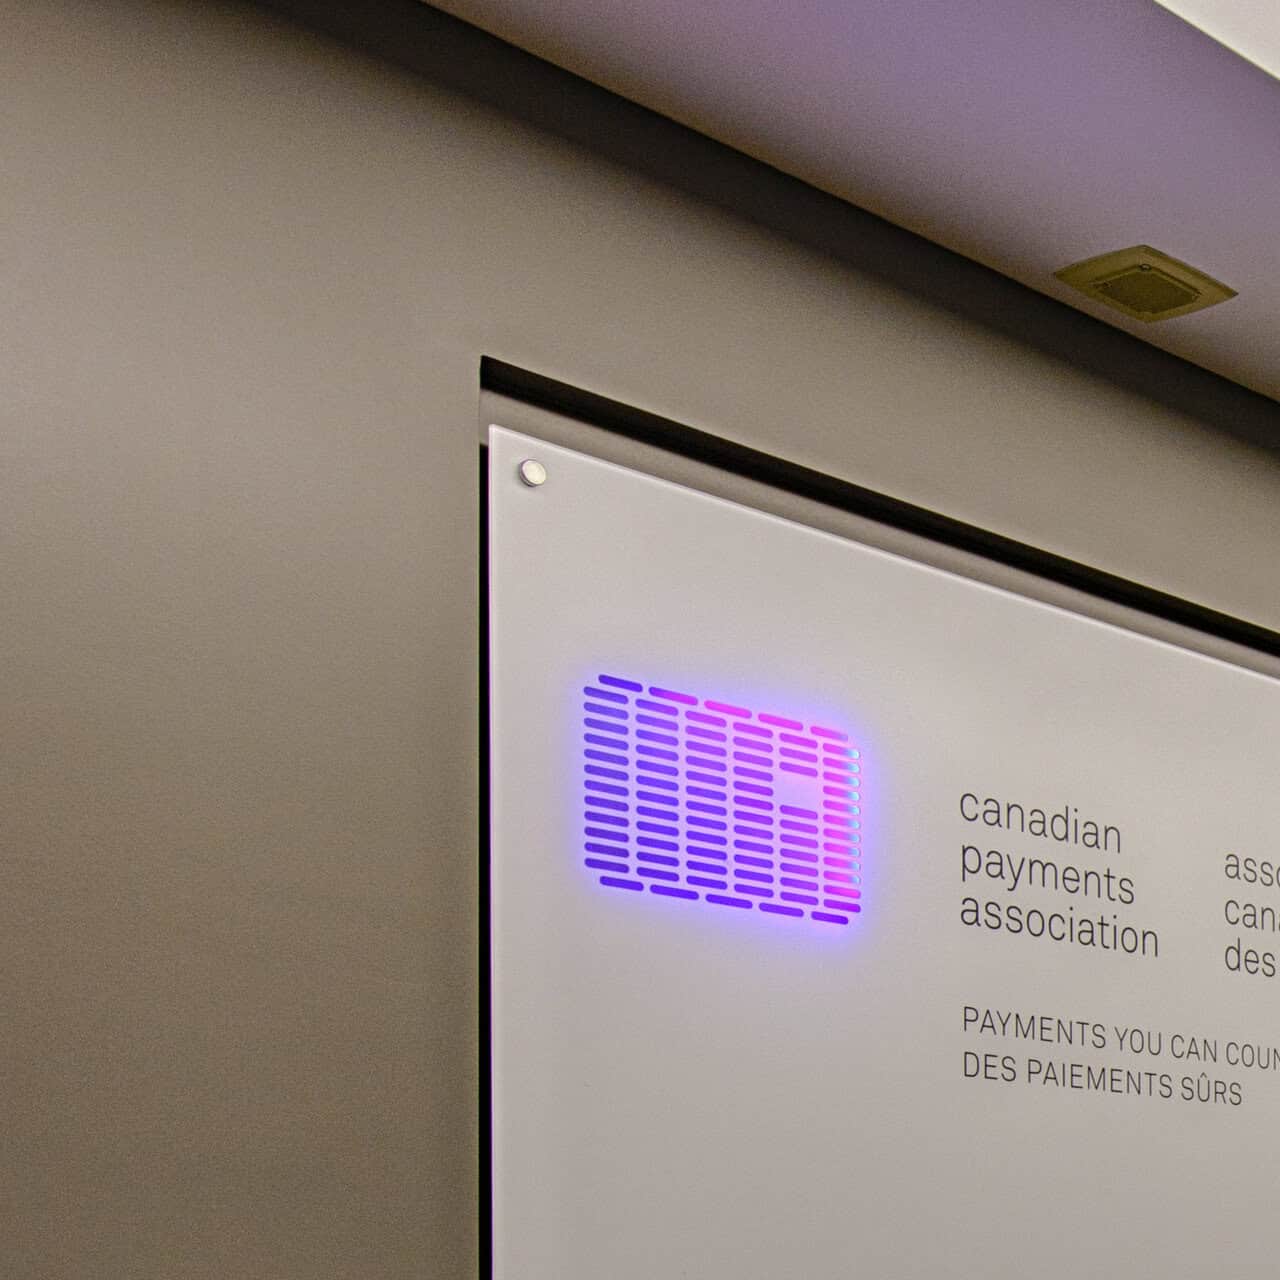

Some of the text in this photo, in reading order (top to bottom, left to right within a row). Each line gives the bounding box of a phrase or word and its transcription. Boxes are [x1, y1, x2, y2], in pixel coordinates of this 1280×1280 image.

[959, 792, 1121, 855] canadian
[961, 844, 1135, 905] payments
[960, 896, 1159, 958] association
[1224, 936, 1277, 978] des
[963, 1005, 1107, 1049] PAYMENTS
[1113, 1026, 1162, 1057] YOU
[1170, 1034, 1217, 1064] CAN
[963, 1050, 1243, 1106] DES PAIEMENTS SÛRS
